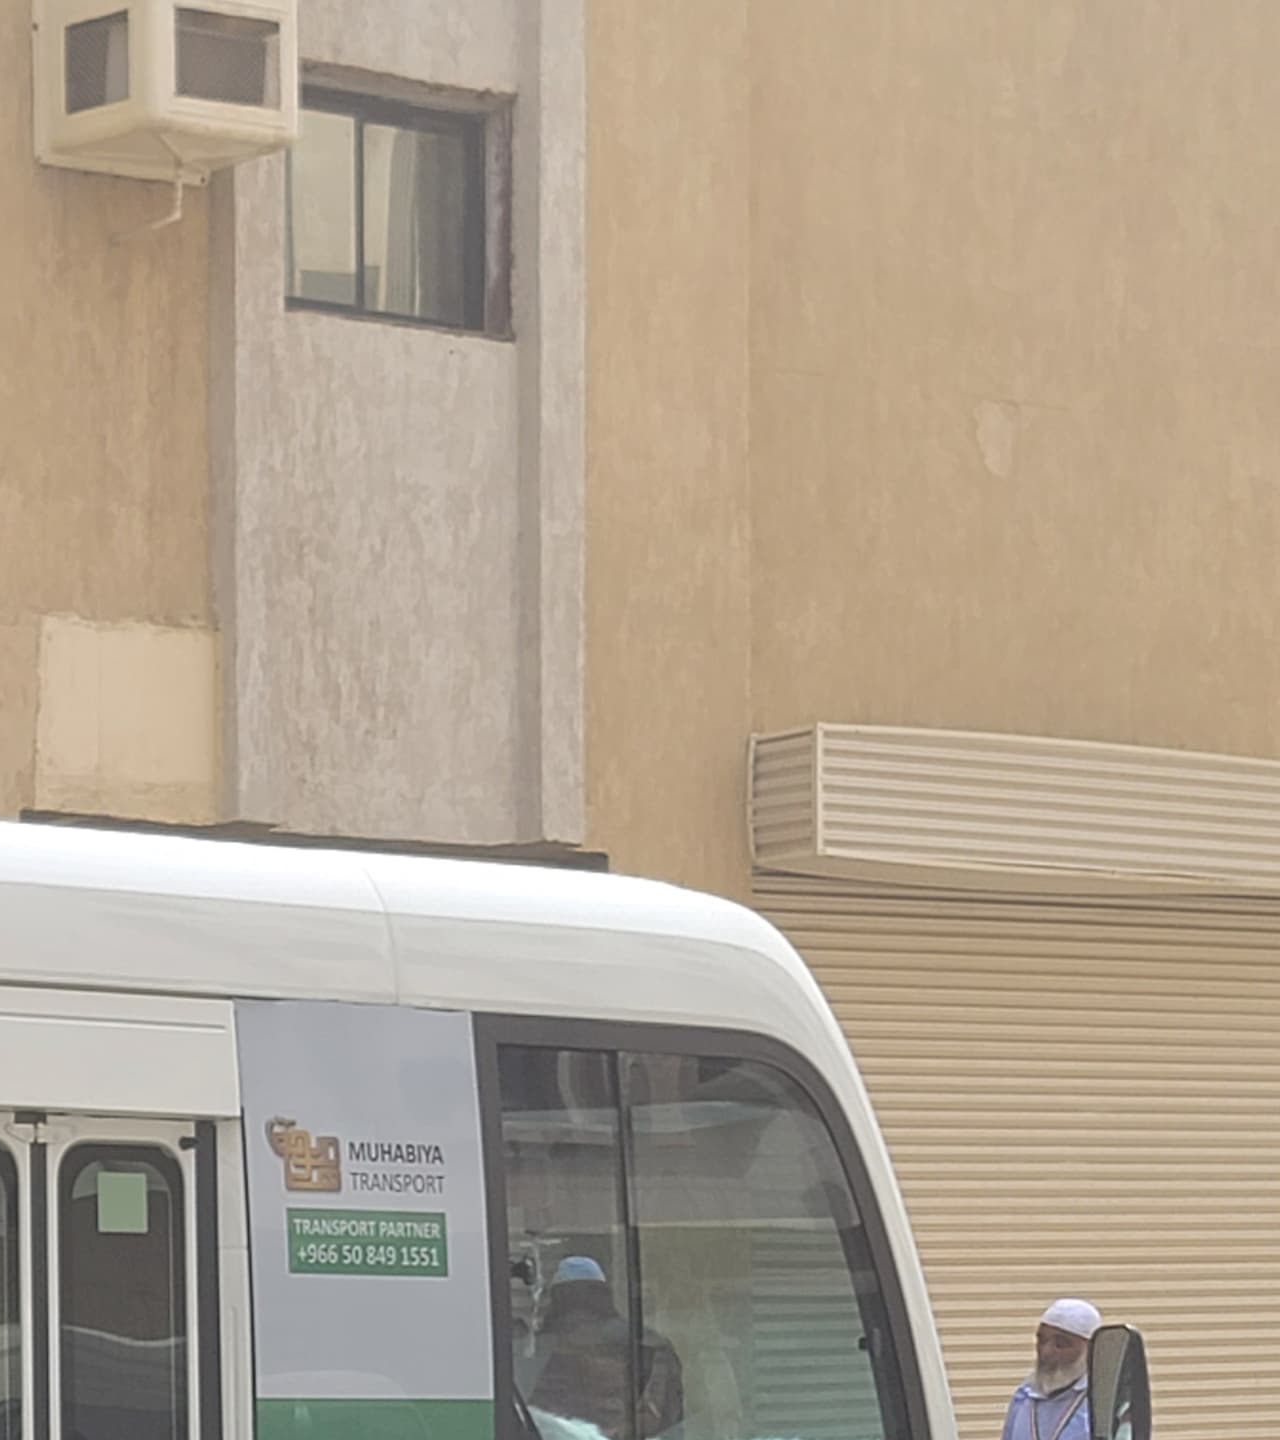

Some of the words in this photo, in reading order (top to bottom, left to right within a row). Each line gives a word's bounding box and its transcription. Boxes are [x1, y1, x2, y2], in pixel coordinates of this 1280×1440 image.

[348, 1142, 444, 1165] MUHABIYA
[350, 1172, 444, 1194] TRANSPORT
[294, 1218, 376, 1238] TRANSPORT
[379, 1221, 440, 1239] PARTNER
[297, 1244, 338, 1265] +966
[342, 1245, 362, 1264] 50
[366, 1245, 396, 1266] 849
[401, 1247, 439, 1267] 1551
